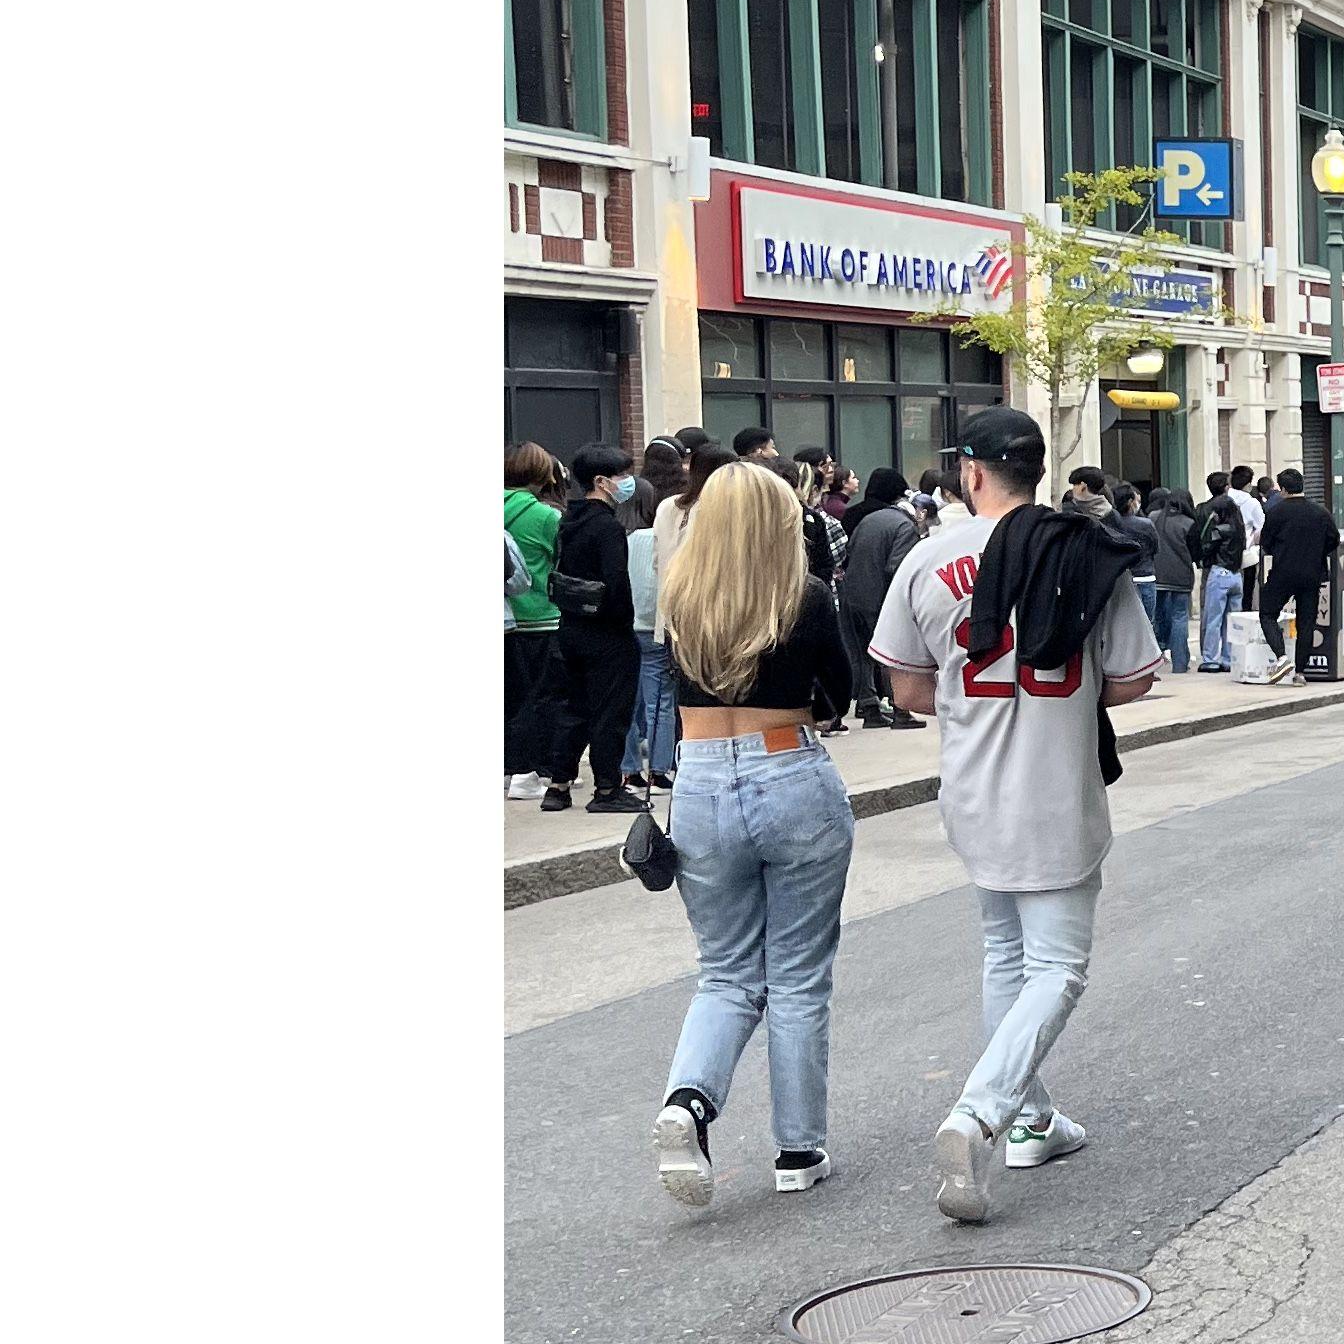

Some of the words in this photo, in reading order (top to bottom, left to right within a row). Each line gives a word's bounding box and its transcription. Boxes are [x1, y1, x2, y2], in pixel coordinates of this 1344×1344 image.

[1163, 149, 1206, 206] P
[764, 237, 835, 281] BANK
[841, 248, 869, 283] OF
[876, 252, 972, 295] AMERICA
